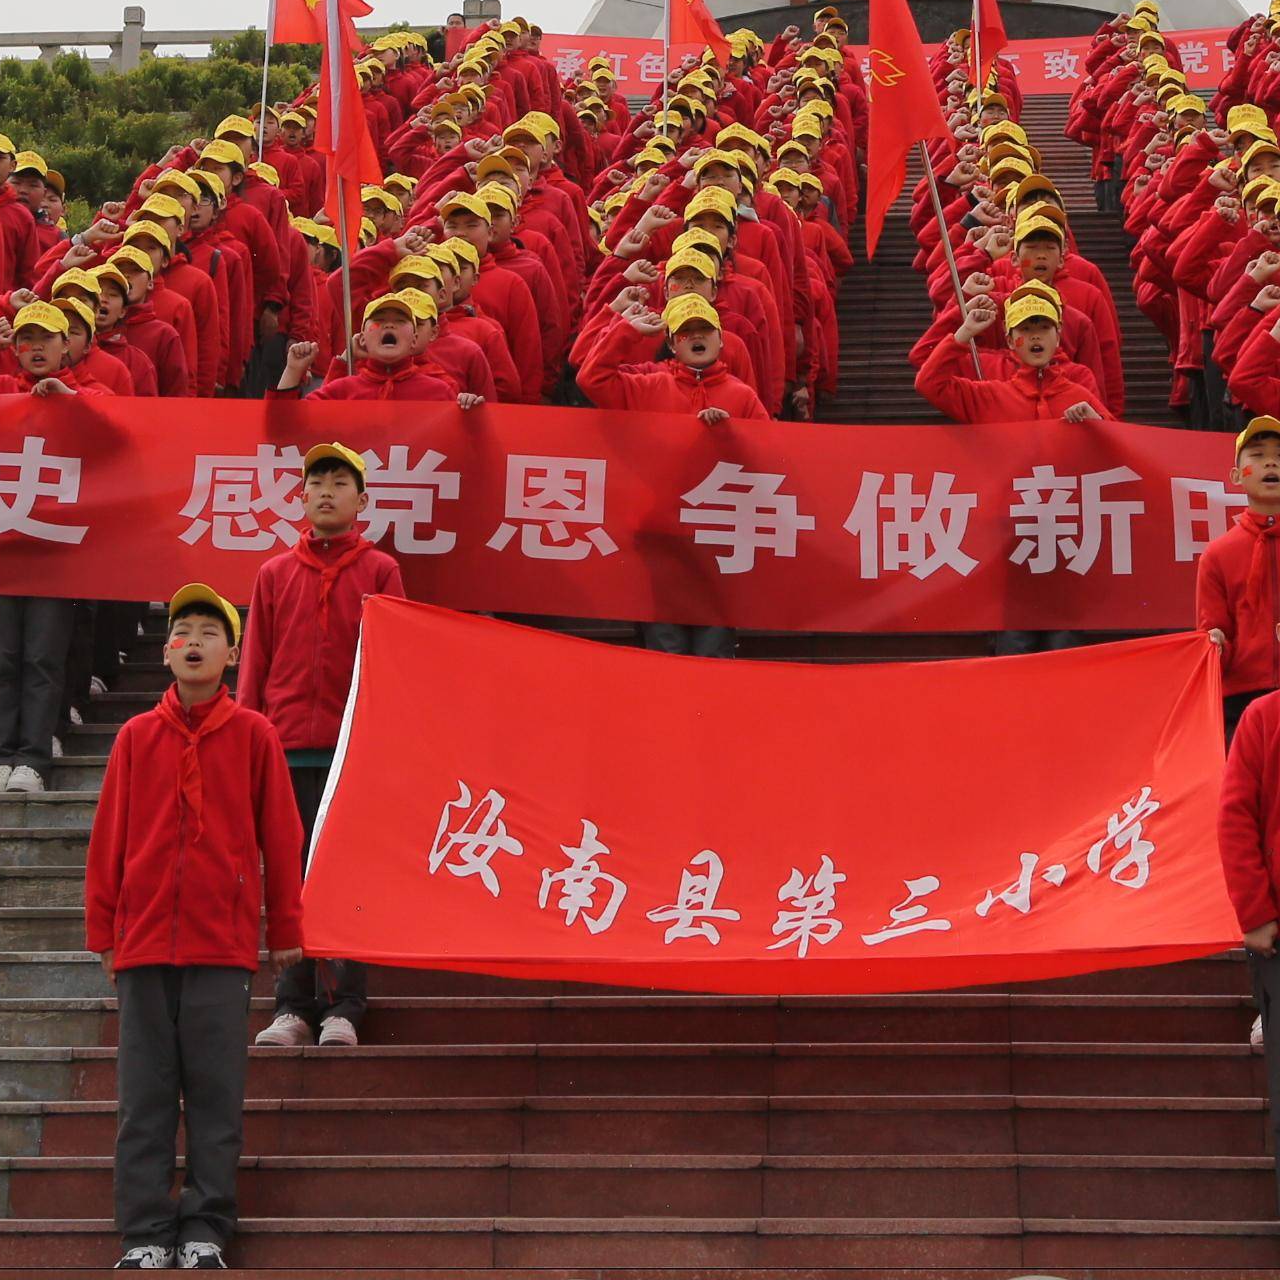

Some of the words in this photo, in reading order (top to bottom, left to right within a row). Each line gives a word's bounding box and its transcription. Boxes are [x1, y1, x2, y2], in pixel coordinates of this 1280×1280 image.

[178, 443, 619, 562] 感党恩
[428, 780, 1161, 958] 汝南县第三小学
